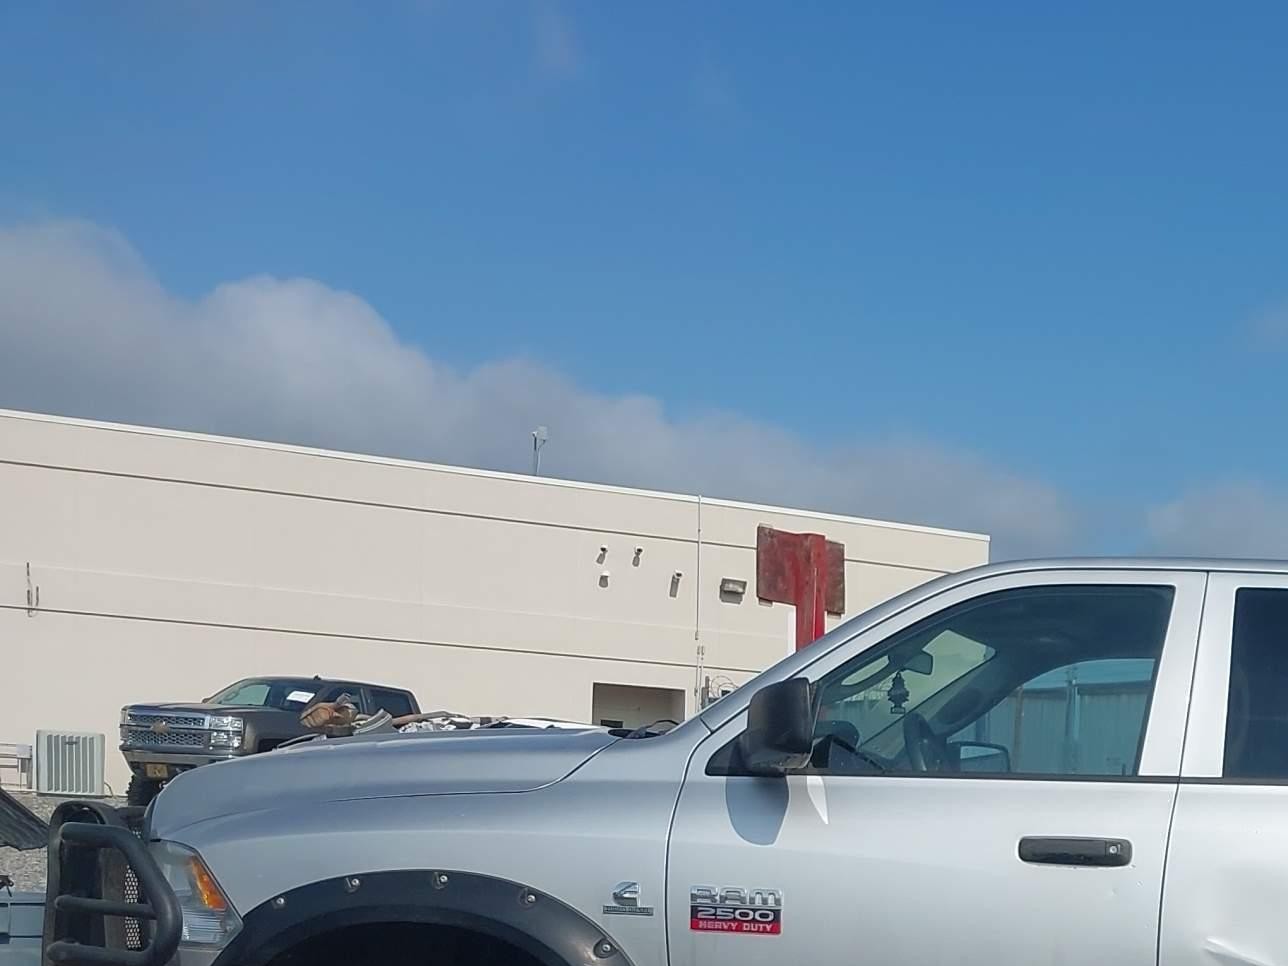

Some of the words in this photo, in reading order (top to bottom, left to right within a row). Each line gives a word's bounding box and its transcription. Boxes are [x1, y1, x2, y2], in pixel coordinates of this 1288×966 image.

[690, 886, 783, 908] RAM
[697, 906, 774, 922] 2500
[698, 920, 738, 931] HEAVY
[743, 922, 773, 932] DUTY
